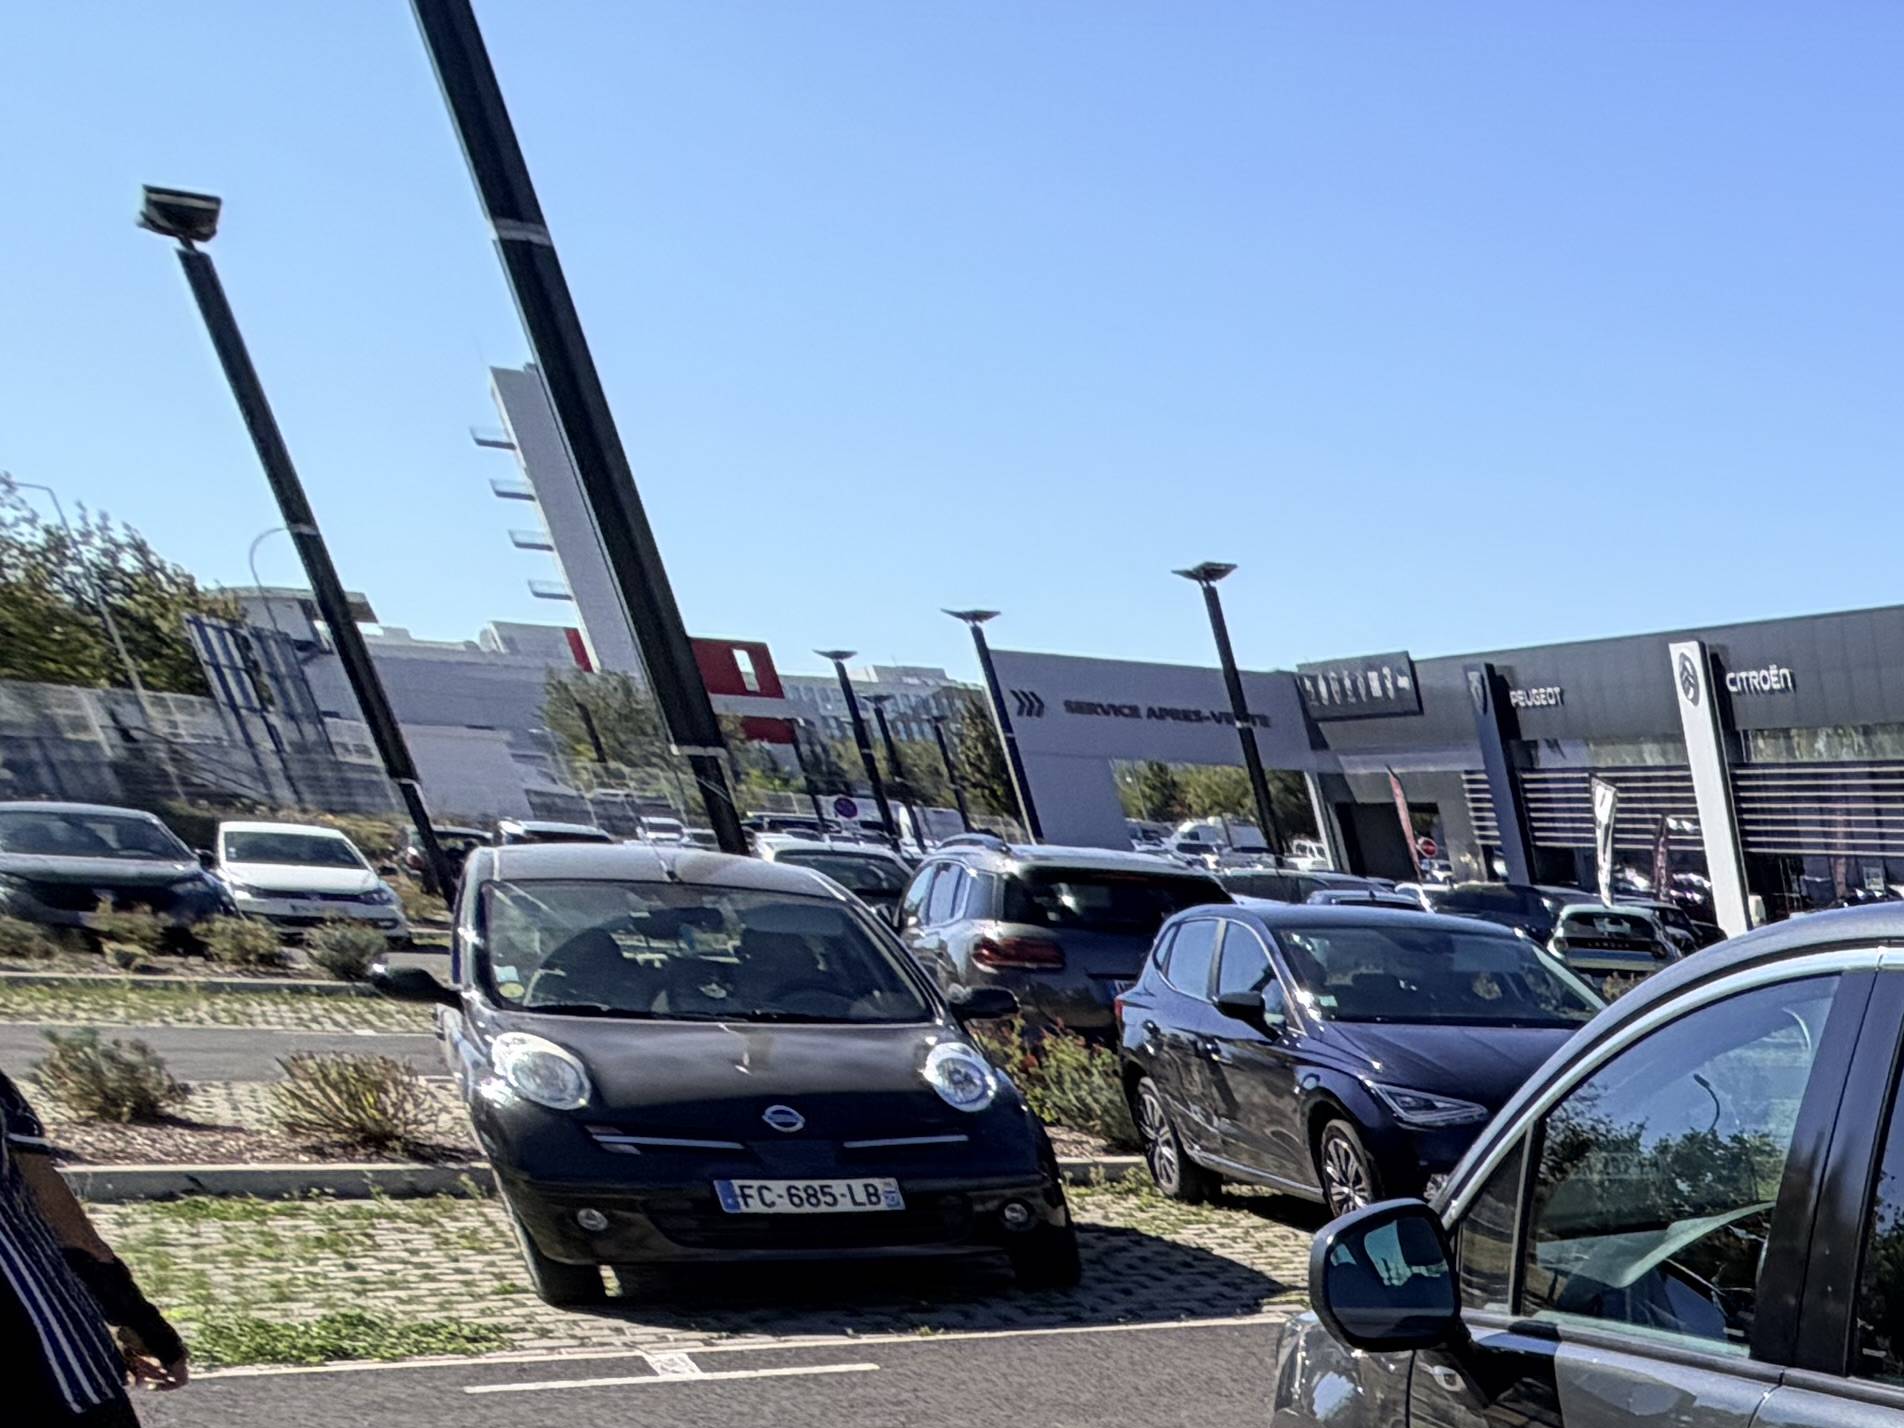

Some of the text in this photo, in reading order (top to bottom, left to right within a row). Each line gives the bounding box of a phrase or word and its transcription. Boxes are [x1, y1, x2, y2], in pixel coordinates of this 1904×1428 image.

[1726, 664, 1794, 695] CITROËN
[1510, 686, 1564, 708] PEUGEOT
[737, 1183, 882, 1209] FC-685-LB
